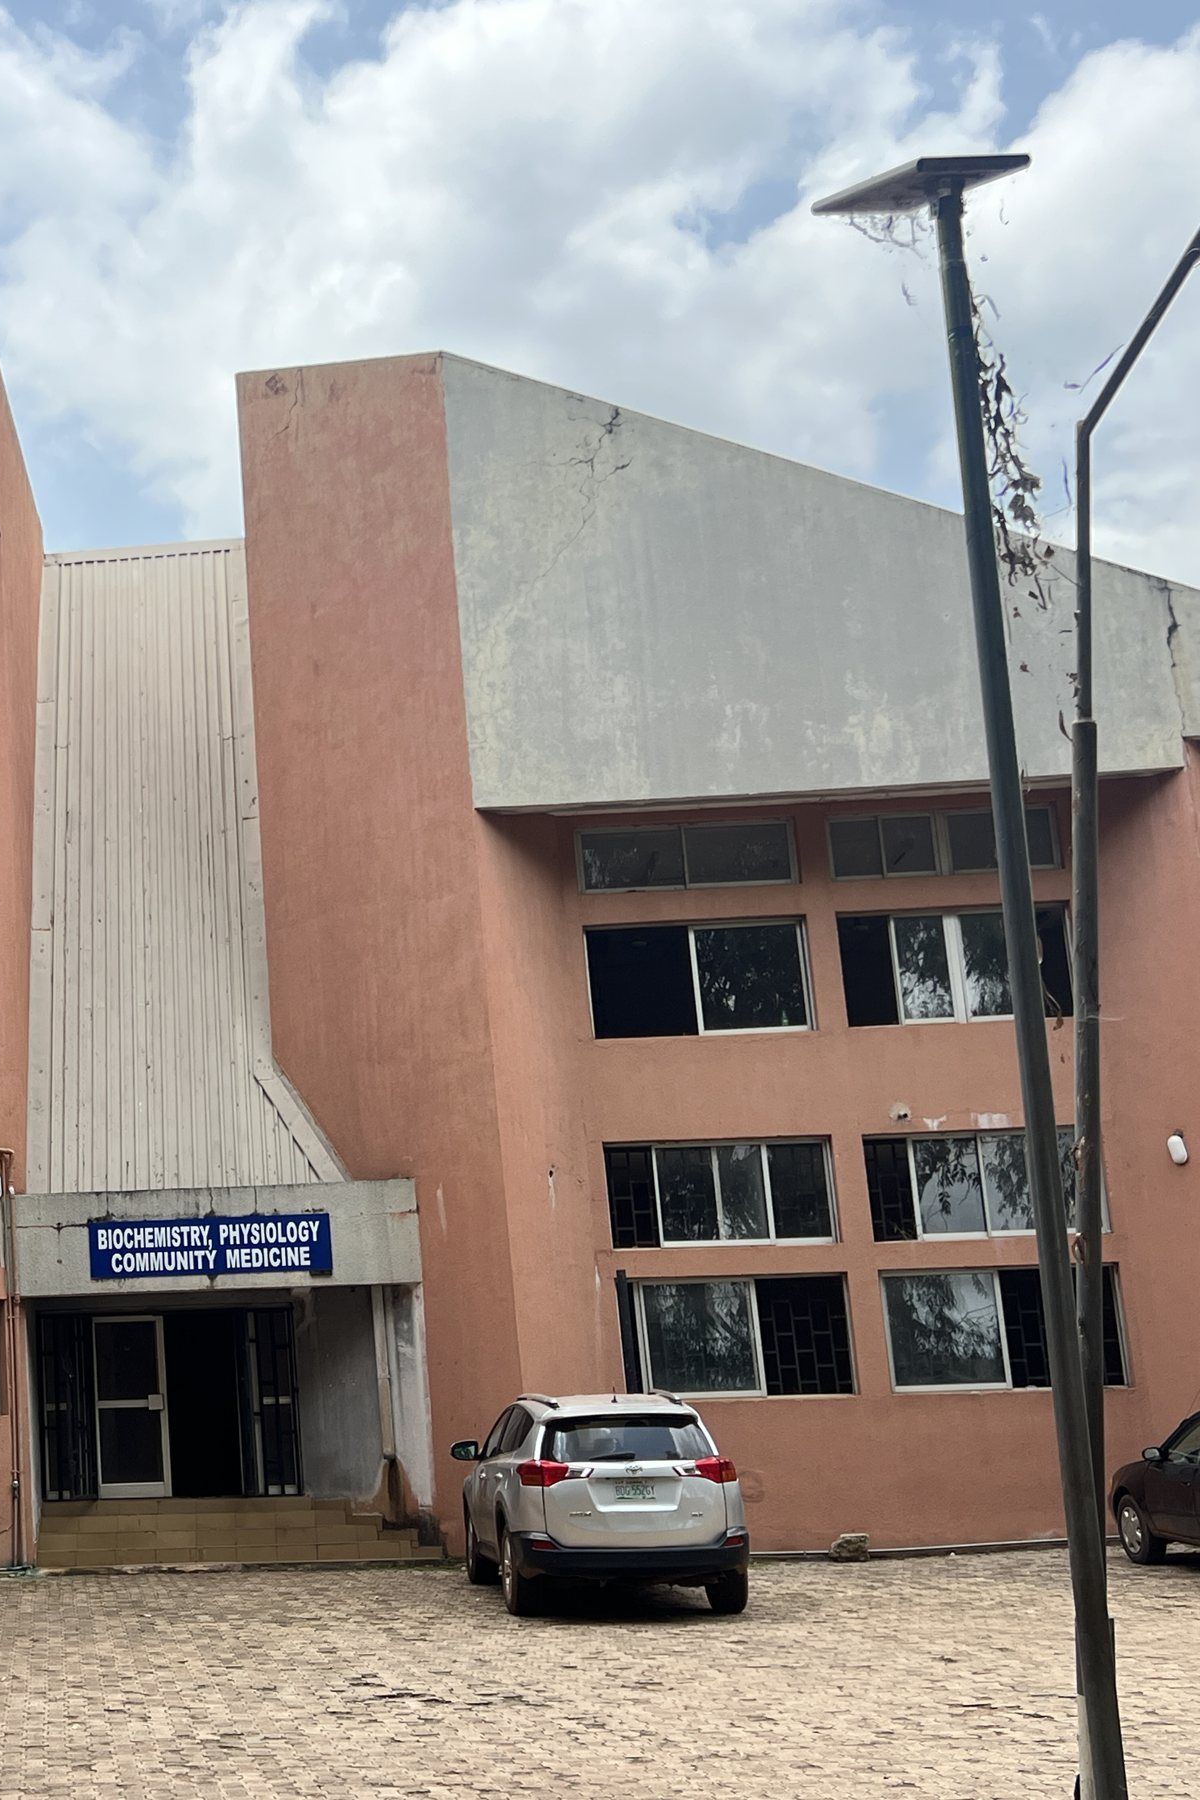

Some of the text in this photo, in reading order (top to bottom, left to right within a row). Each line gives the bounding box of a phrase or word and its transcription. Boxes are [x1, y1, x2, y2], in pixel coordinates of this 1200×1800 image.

[97, 1220, 320, 1250] BIOCHEMISTRY, PHYSIOLOGY
[111, 1246, 311, 1273] COMMUNITY MEDICINE
